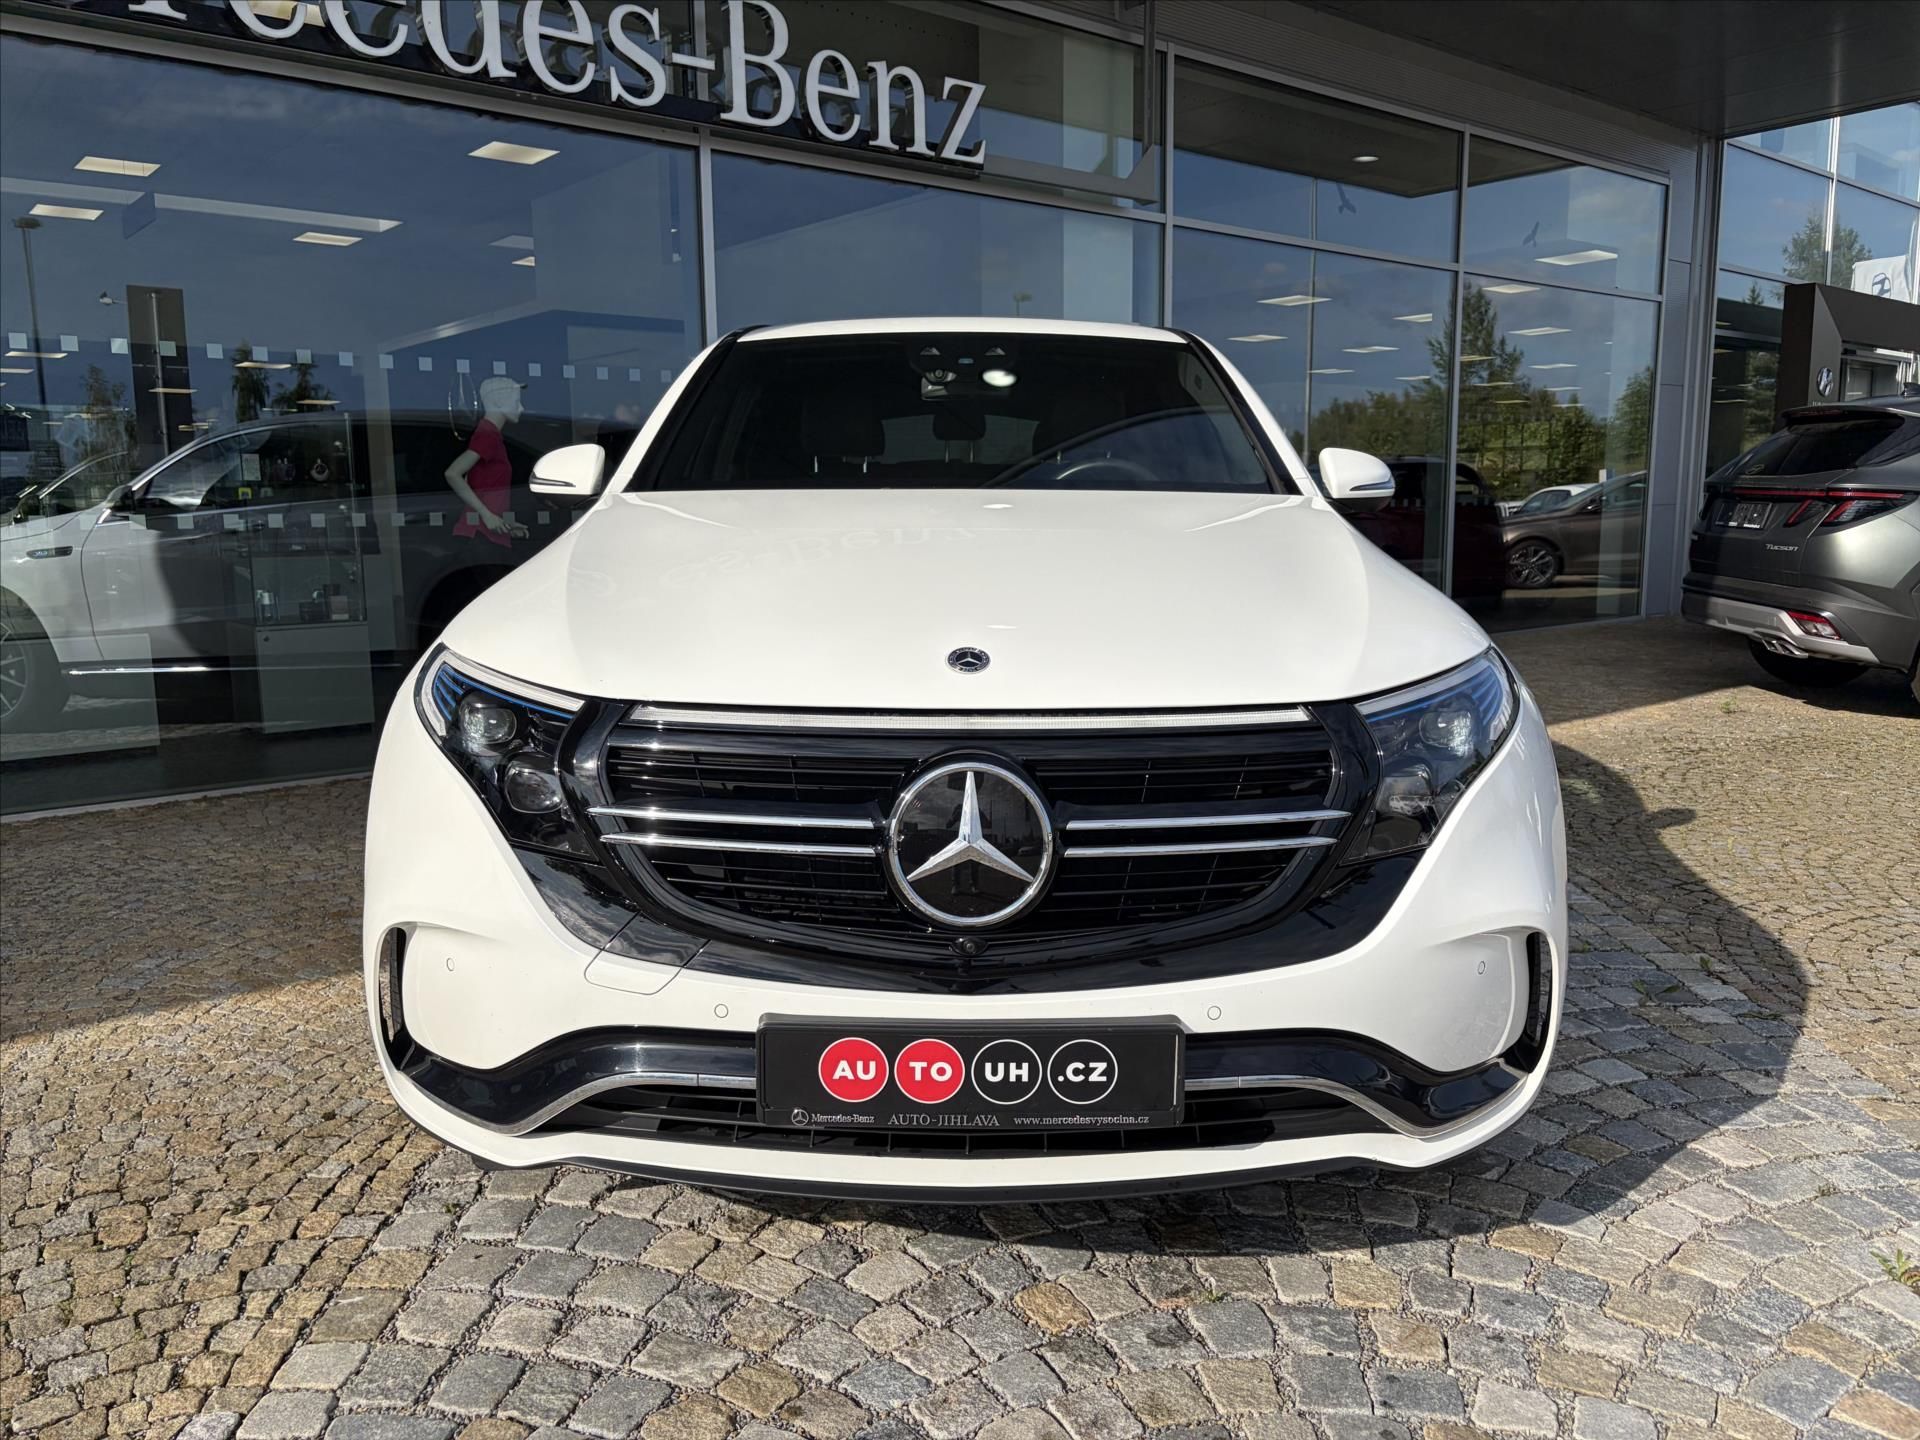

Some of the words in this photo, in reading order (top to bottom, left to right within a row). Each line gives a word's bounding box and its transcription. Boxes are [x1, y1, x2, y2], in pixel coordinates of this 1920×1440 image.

[128, 0, 986, 164] es-Benz
[811, 1113, 875, 1124] Mercedes-Benz
[888, 1113, 1000, 1126] AUTO-JIHLAVA
[1014, 1114, 1150, 1126] www.mercedesvysocina.cz
